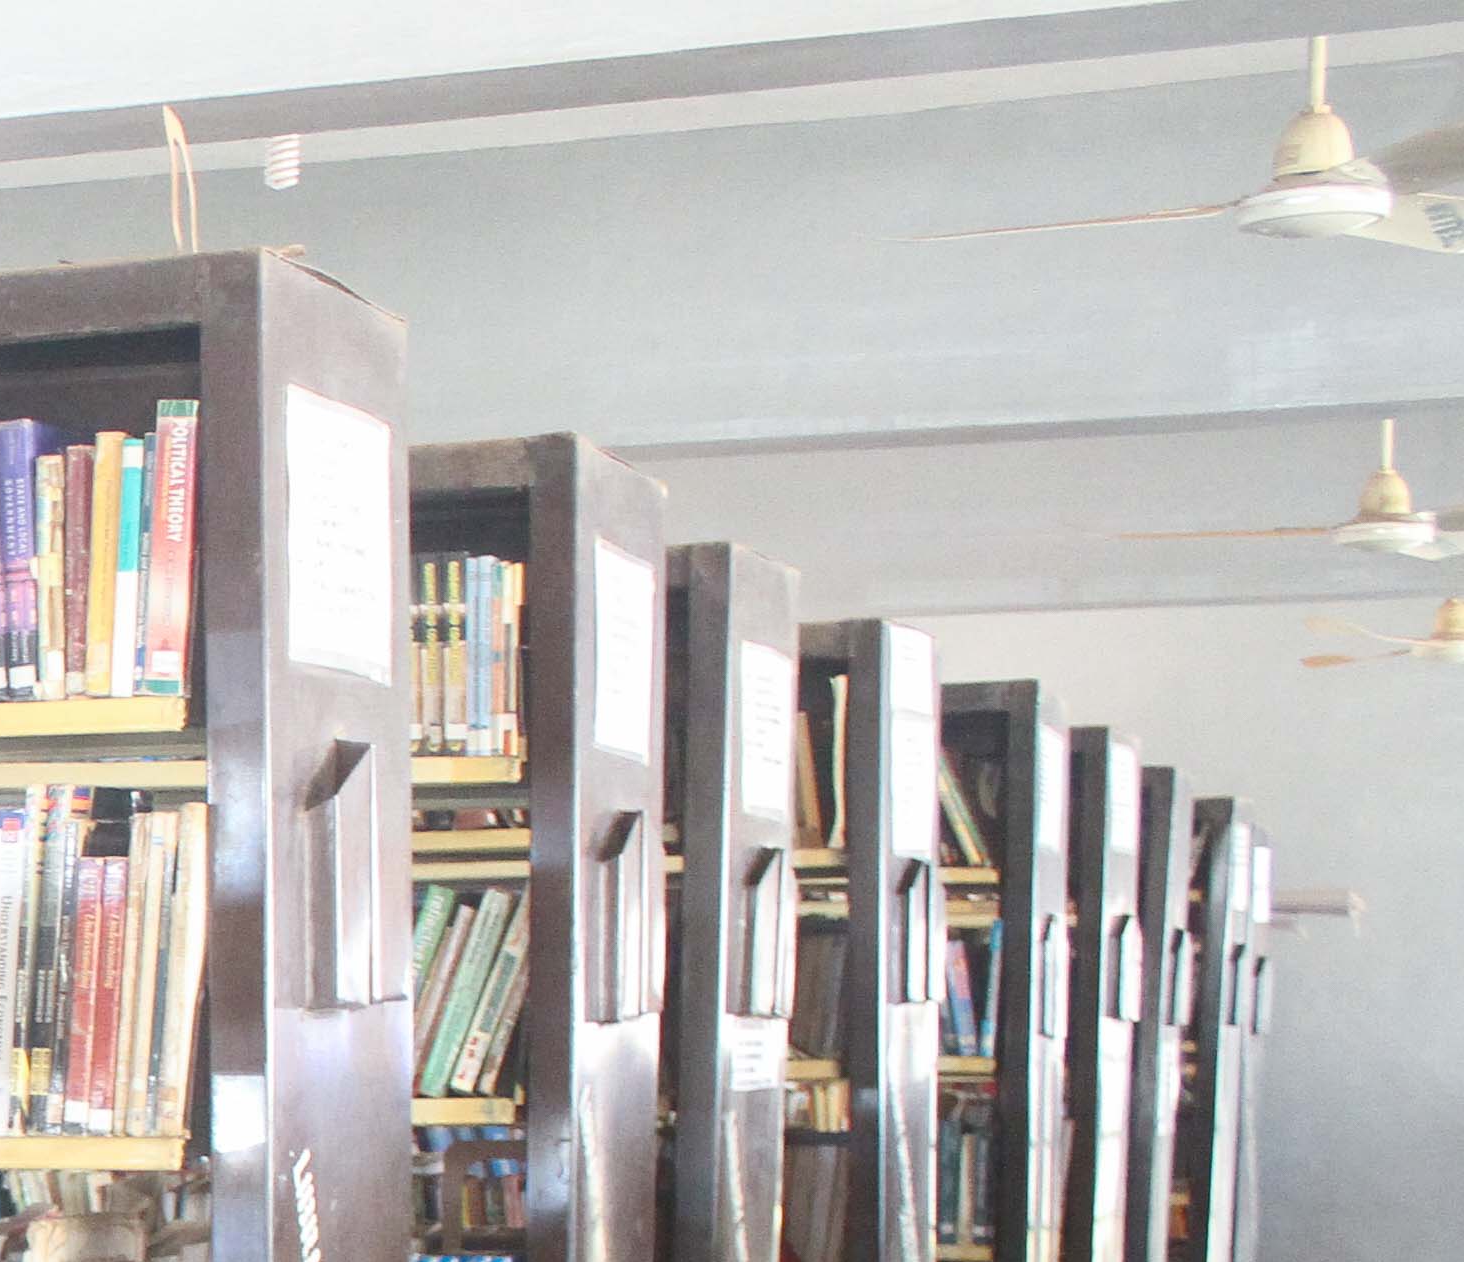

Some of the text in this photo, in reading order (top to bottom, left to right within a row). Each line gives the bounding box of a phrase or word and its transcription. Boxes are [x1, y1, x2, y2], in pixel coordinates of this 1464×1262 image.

[4, 478, 18, 558] GOVERNMENT
[16, 478, 30, 556] STATE AND LOCAL
[165, 420, 189, 542] POLITICAL THEORY
